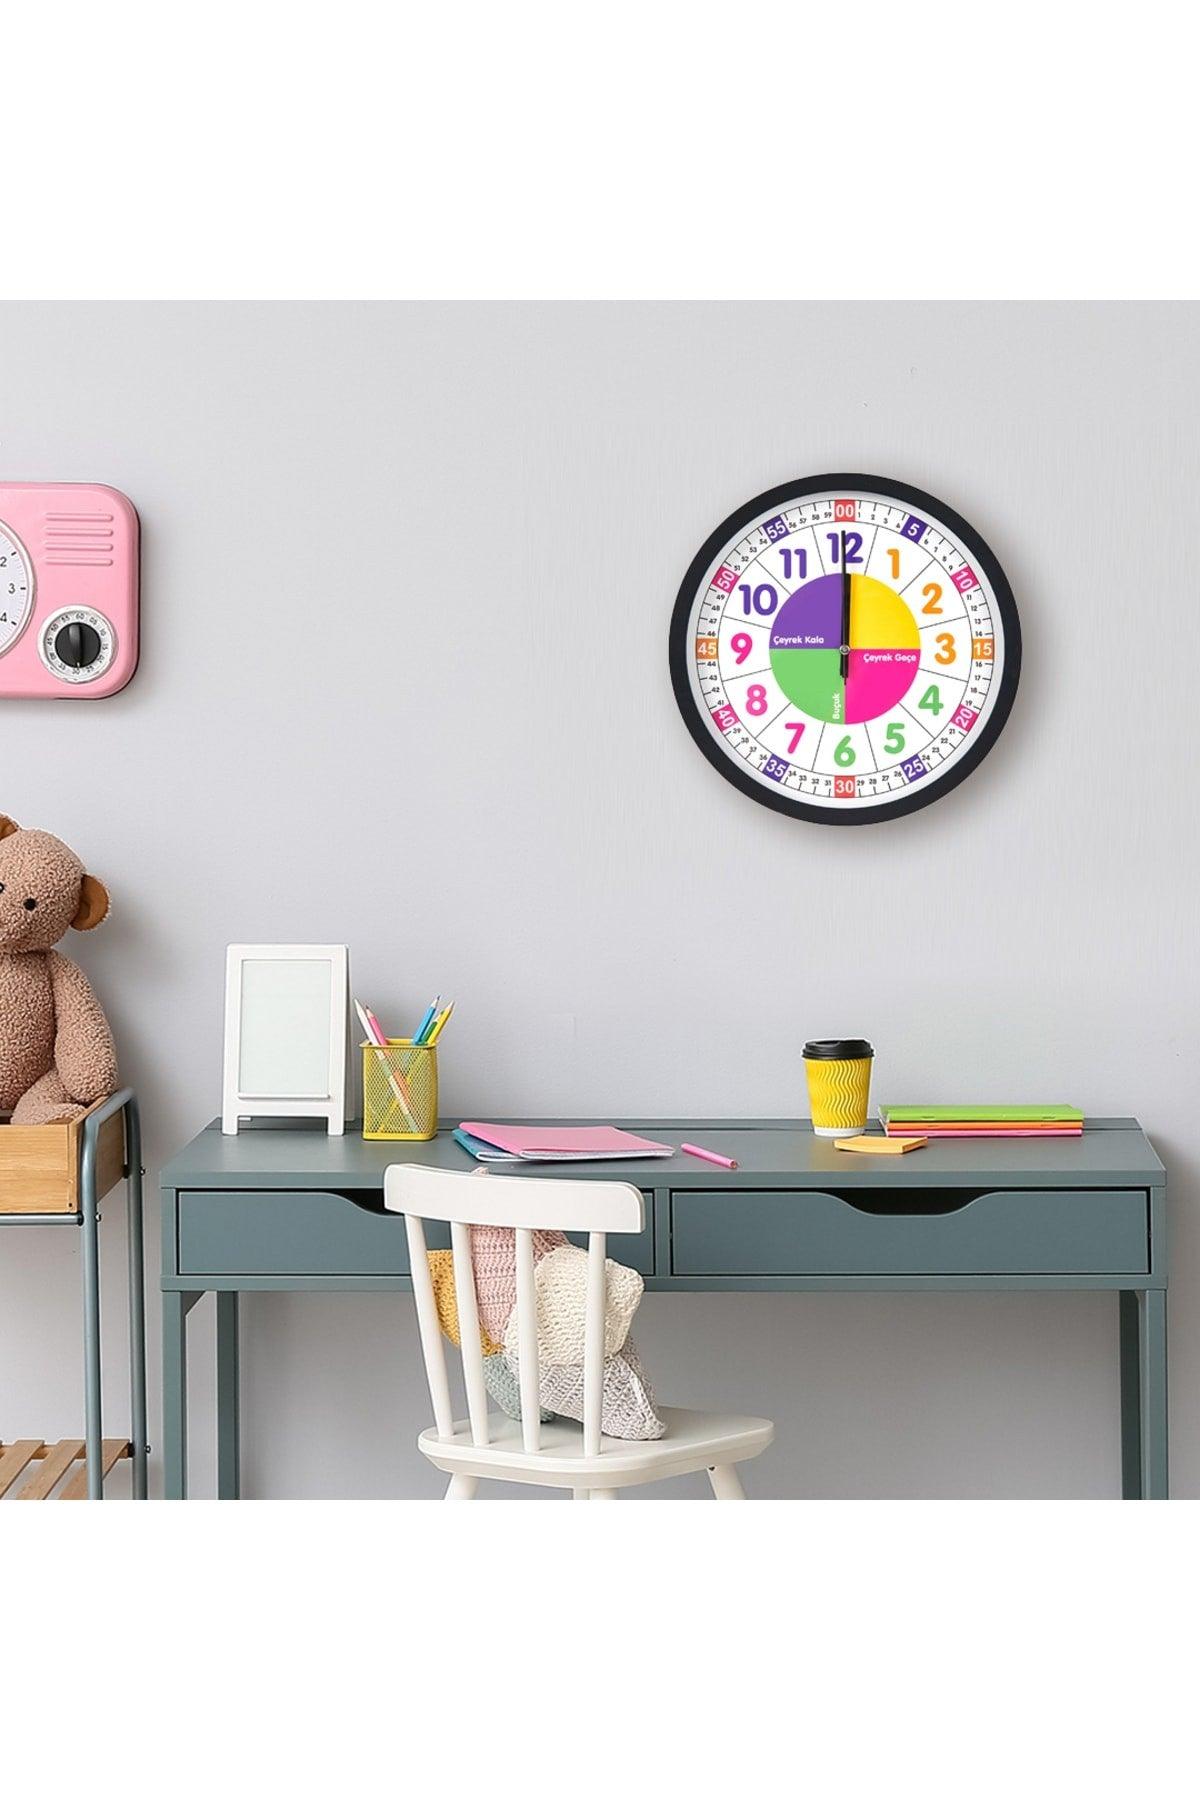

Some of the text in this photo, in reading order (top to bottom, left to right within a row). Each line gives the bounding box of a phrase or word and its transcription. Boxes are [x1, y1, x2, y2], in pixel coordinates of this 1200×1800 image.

[836, 504, 854, 517] 00
[767, 520, 786, 539] 55
[908, 523, 920, 536] 5
[826, 532, 864, 564] 12
[0, 556, 7, 568] 2
[779, 548, 807, 579] 11
[886, 548, 900, 580] 1
[8, 583, 16, 594] 3
[717, 571, 735, 590] 50
[956, 571, 973, 589] 10
[738, 584, 778, 616] 10
[922, 582, 943, 614] 2
[0, 612, 7, 622] 4
[698, 642, 716, 655] 45
[731, 632, 752, 664] 9
[774, 636, 802, 646] Çeyrek
[934, 632, 956, 664] 3
[974, 643, 992, 655] 15
[864, 653, 916, 664] Çeyrek Geçe
[746, 684, 768, 716] 8
[832, 693, 842, 720] Buçuk
[918, 685, 944, 716] 4
[718, 710, 735, 728] 40
[956, 710, 973, 728] 20
[785, 722, 806, 754] 7
[884, 722, 906, 754] 5
[834, 736, 856, 768] 6
[766, 759, 786, 778] 35
[904, 759, 924, 778] 25
[836, 780, 854, 793] 30
